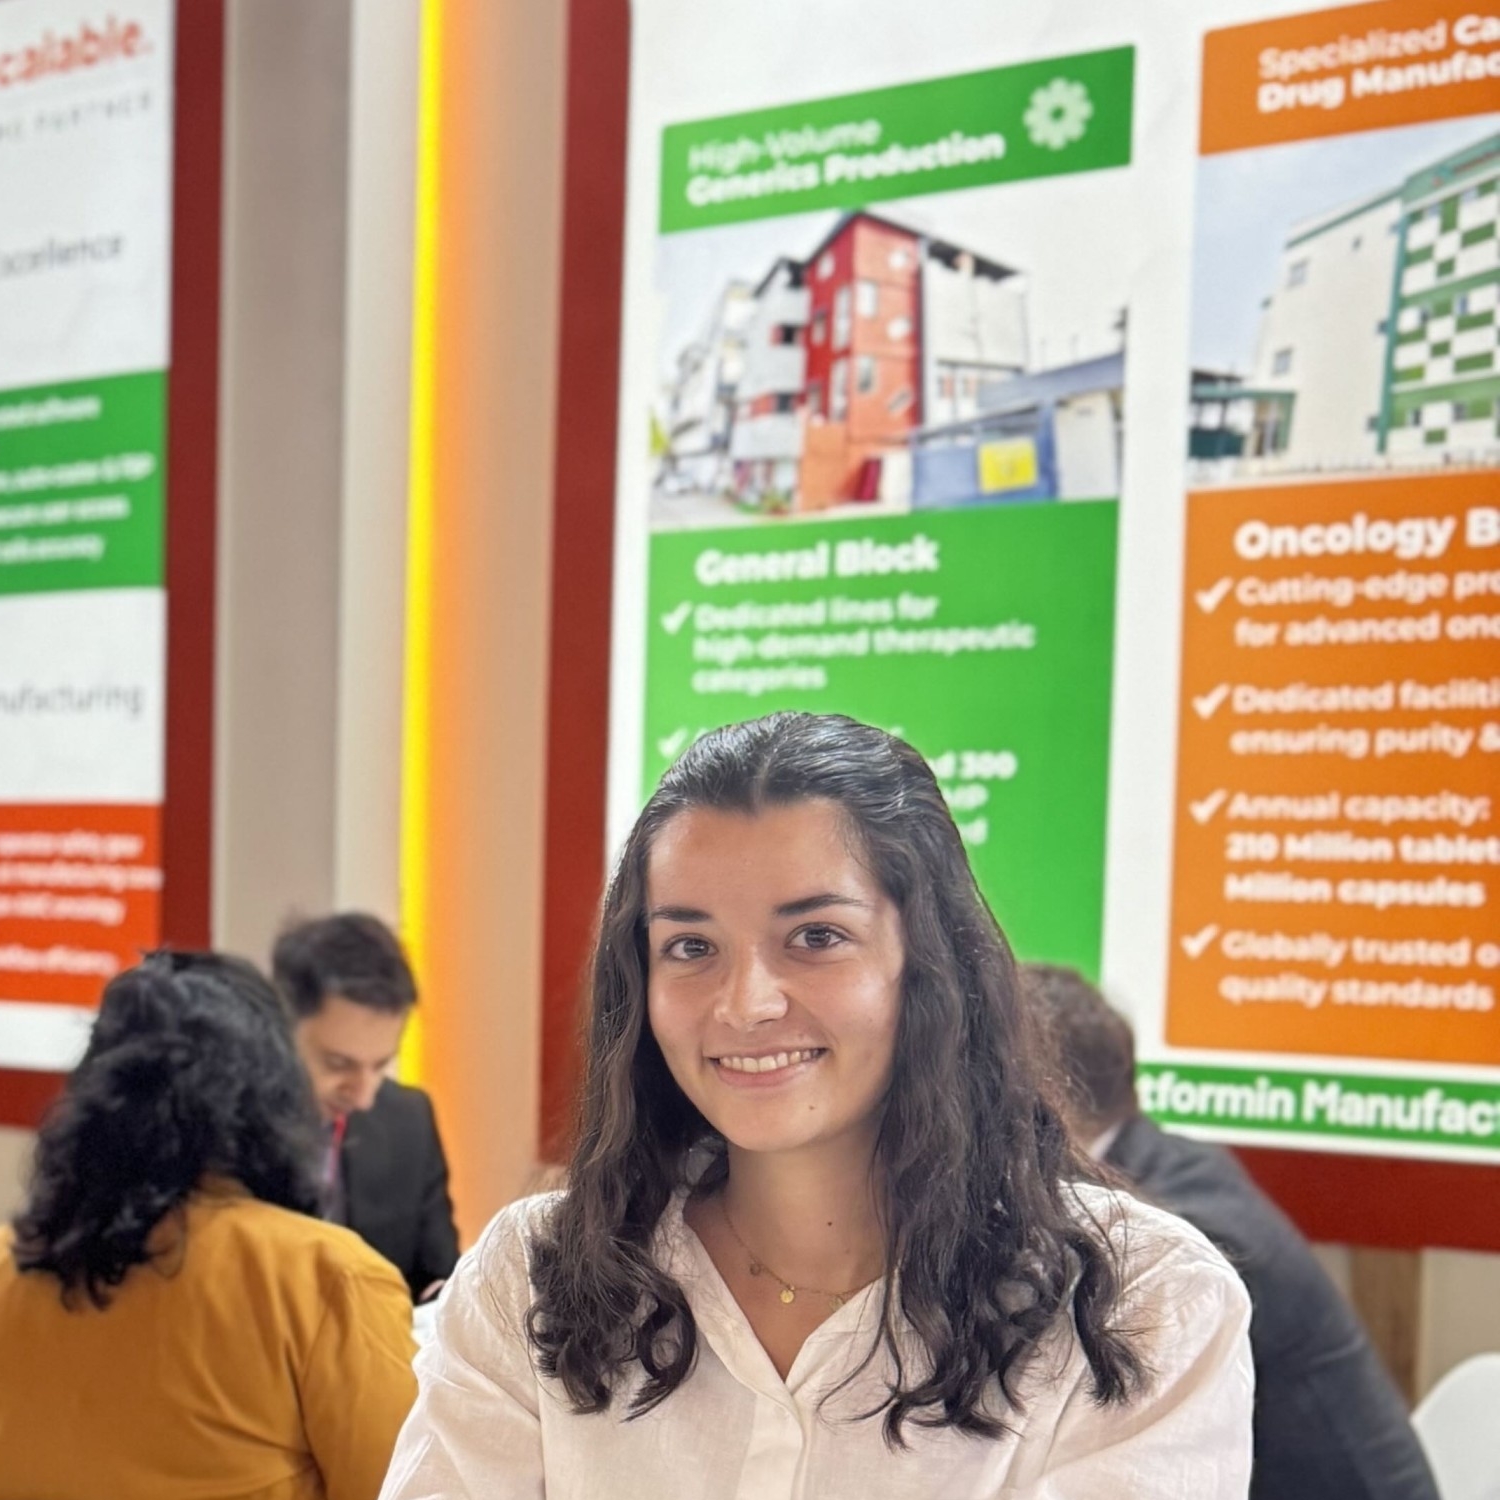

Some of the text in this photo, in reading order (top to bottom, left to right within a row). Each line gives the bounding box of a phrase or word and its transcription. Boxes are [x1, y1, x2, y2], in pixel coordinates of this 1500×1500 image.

[1259, 18, 1448, 80] Specialized
[1257, 75, 1345, 114] Drug
[688, 119, 882, 173] High-Volume
[824, 131, 1005, 185] Production
[1234, 512, 1457, 560] Oncology
[695, 533, 940, 587] General Block
[1235, 570, 1449, 607] Cutting-edge
[694, 591, 940, 633] Dedicated lines for
[1234, 617, 1280, 647] for
[1284, 611, 1441, 645] advanced
[692, 619, 1037, 667] high-demand therapeutic
[692, 662, 827, 697] categories
[1232, 681, 1394, 714] Dedicated
[1229, 722, 1370, 760] ensuring
[1374, 721, 1475, 758] purity
[959, 749, 1017, 780] 300
[1226, 789, 1491, 828] Annual capacity:
[1225, 831, 1280, 862] 210
[1283, 830, 1394, 861] Million
[1224, 870, 1486, 911] Million capsules
[1221, 930, 1348, 968] Globally
[1352, 936, 1471, 968] trusted
[1219, 972, 1494, 1013] quality standards
[1301, 1077, 1500, 1137] Manufac
